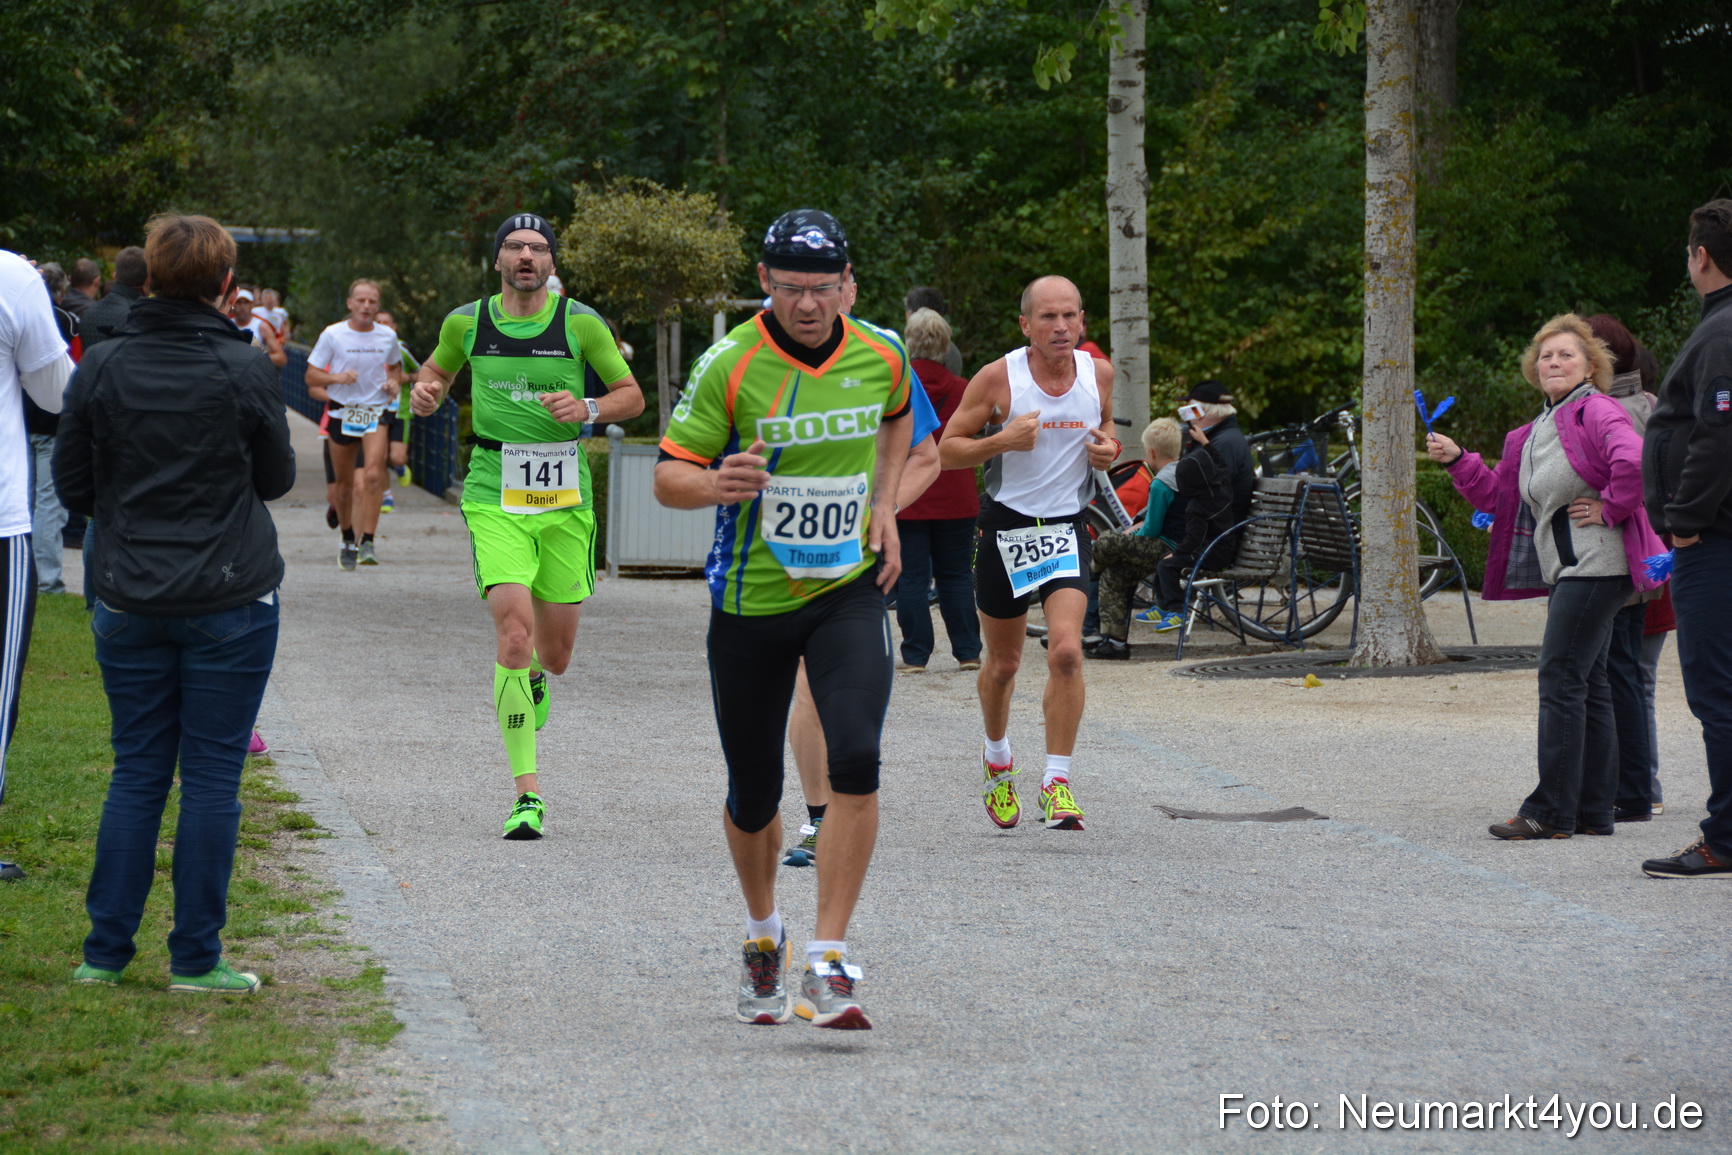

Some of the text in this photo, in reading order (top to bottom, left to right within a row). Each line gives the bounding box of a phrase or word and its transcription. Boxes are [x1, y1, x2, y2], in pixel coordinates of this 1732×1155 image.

[528, 382, 547, 391] Run
[556, 381, 567, 390] Fit
[756, 403, 883, 448] BOCK
[1042, 421, 1088, 429] KLEBL
[504, 449, 567, 457] PARTL Neumarkt
[520, 460, 563, 487] 141
[526, 494, 558, 505] Daniel
[766, 486, 854, 497] PARTL Neumarkt
[1104, 486, 1130, 527] KETTLER
[774, 500, 858, 539] 2809
[789, 549, 840, 564] Thomas
[1008, 535, 1070, 568] 2552
[1026, 560, 1060, 582] Berthold
